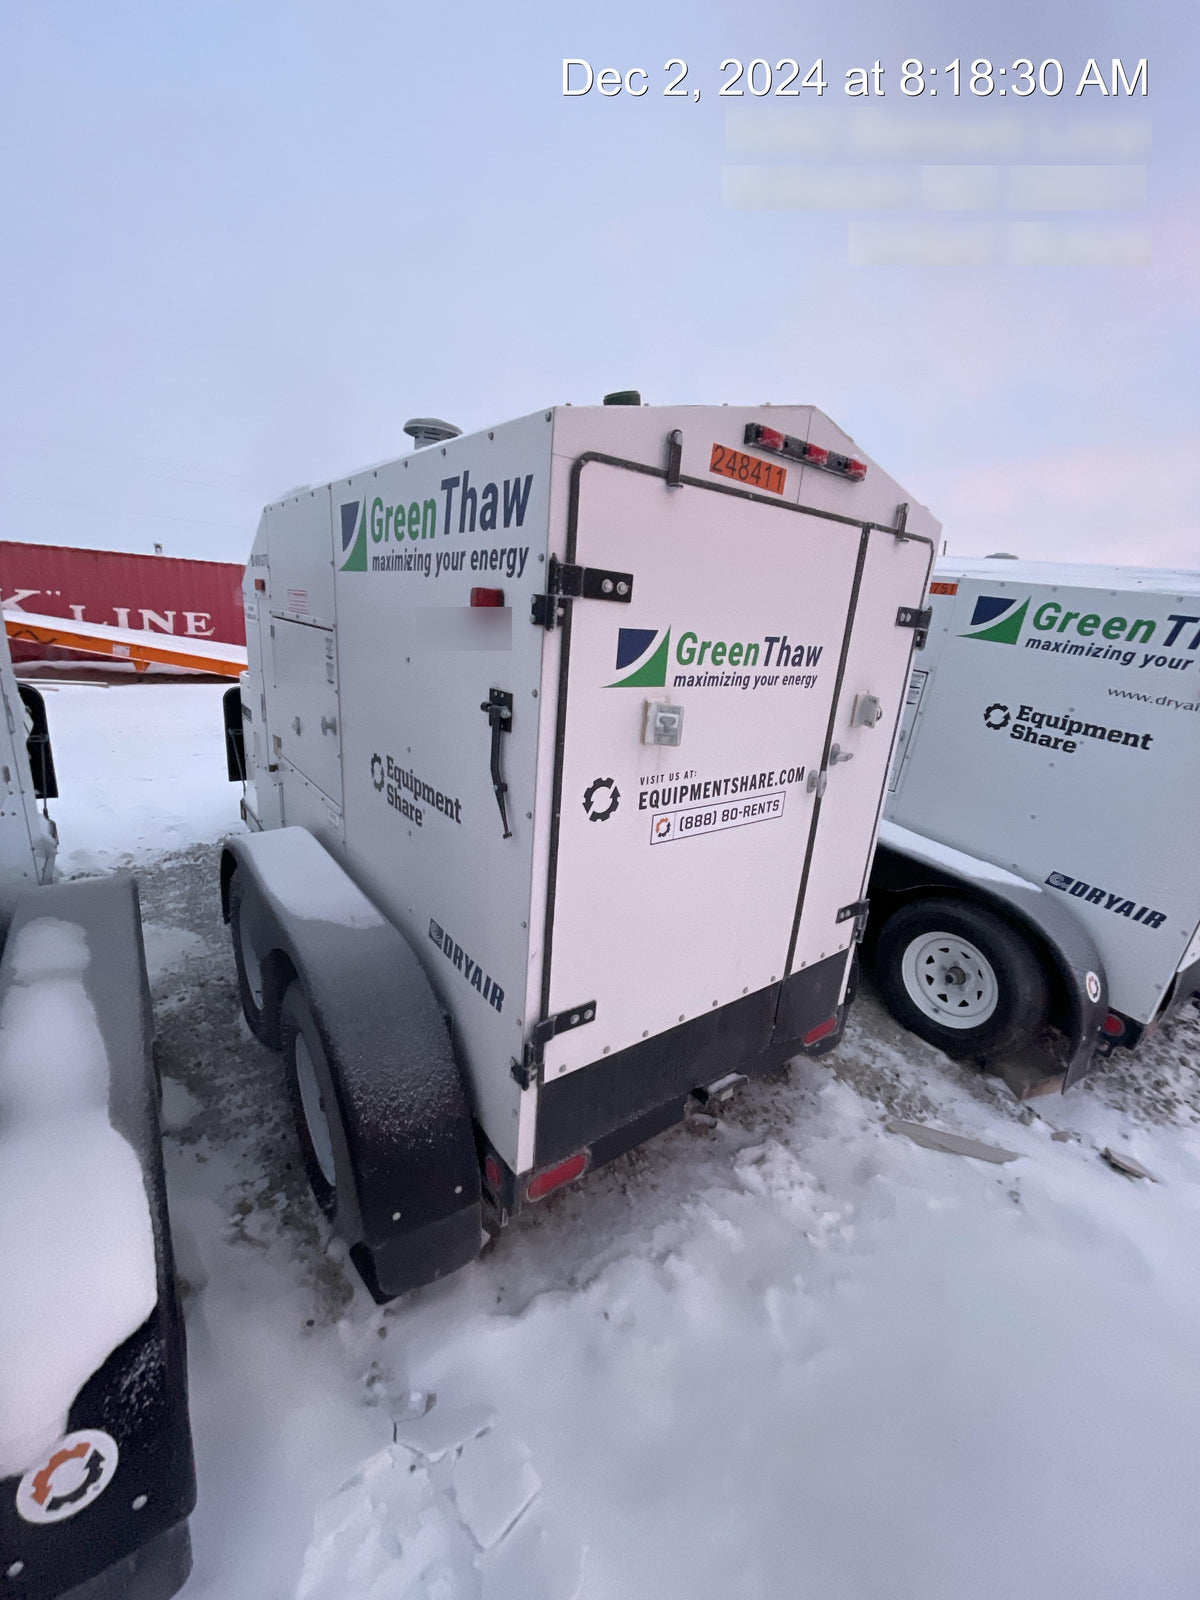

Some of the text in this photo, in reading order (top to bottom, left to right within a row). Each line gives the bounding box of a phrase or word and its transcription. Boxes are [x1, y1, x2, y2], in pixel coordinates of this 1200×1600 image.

[711, 444, 785, 492] 248411
[372, 546, 530, 579] maximizing your energy
[1025, 637, 1194, 671] maximizing your
[673, 670, 818, 690] maximizing your energy
[1010, 722, 1077, 754] Share
[1016, 704, 1154, 751] Equipment
[386, 755, 462, 825] Equipment
[638, 766, 806, 811] EQUIPMENTSHARE.COM
[640, 770, 698, 786] VISIT US AT:
[386, 783, 423, 827] Share
[679, 799, 780, 832] (888) 80-RENTS
[1069, 881, 1168, 929] DRYAIR
[443, 932, 505, 1014] DRYAIR
